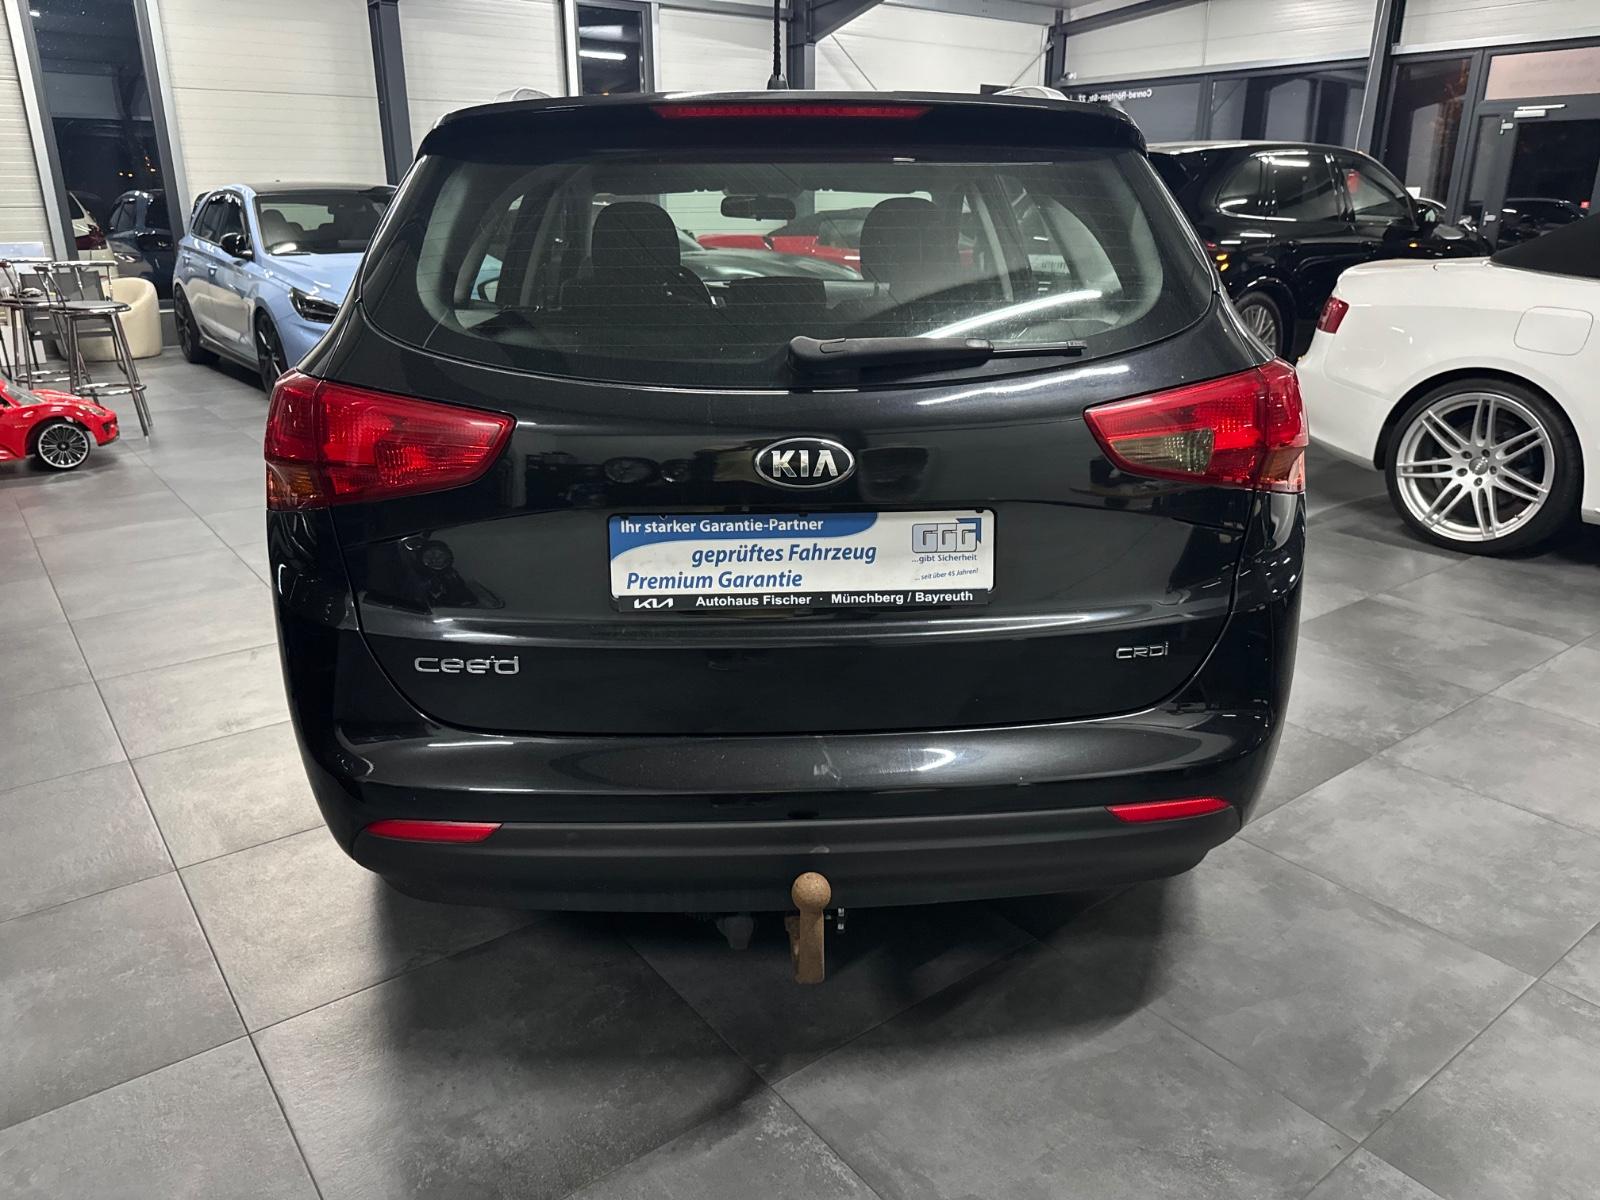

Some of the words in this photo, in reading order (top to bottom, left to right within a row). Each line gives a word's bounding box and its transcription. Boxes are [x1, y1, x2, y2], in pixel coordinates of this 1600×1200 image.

[771, 449, 838, 477] KIA
[620, 520, 641, 534] Ihr
[645, 520, 696, 533] starker
[700, 518, 824, 533] Garantie-Partner
[912, 521, 979, 553] GGG
[691, 544, 784, 568] geprüftes
[788, 543, 877, 565] Fahrzeug
[937, 553, 977, 562] Sicherheit
[626, 571, 713, 590] Premium
[718, 569, 803, 588] Garantie
[932, 571, 946, 579] über
[695, 595, 759, 607] Autohaus
[763, 594, 812, 605] Fischer
[831, 592, 904, 605] Münchberg
[915, 590, 973, 604] Bayreuth
[1115, 641, 1169, 659] CRDi
